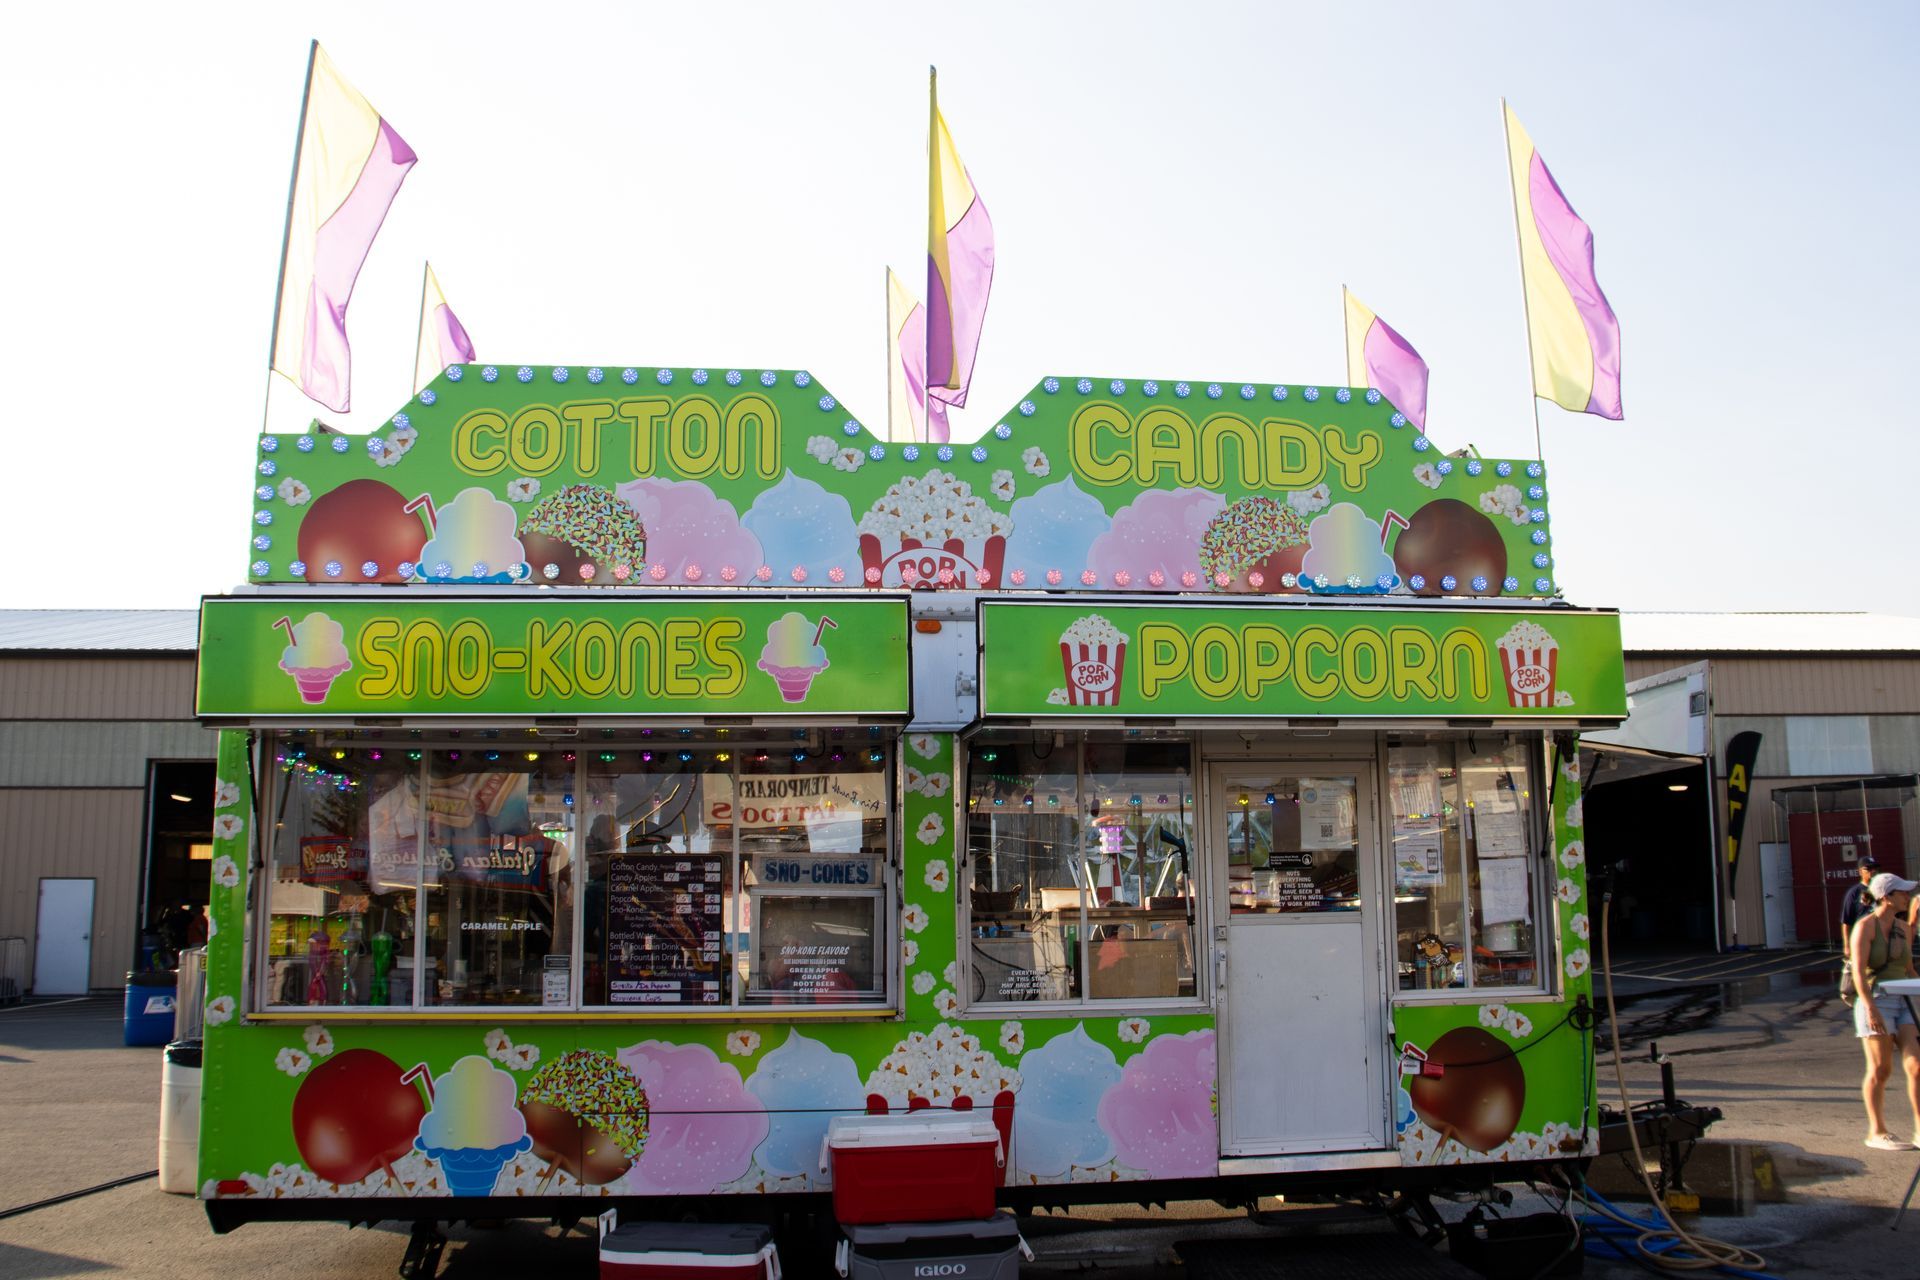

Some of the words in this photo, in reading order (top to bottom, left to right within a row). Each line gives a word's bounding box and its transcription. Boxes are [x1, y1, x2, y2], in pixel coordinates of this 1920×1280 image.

[451, 392, 782, 480] COTTON
[1068, 400, 1384, 492] CANDY
[898, 556, 957, 582] POP
[356, 617, 748, 700] SNO-KONES
[1137, 621, 1493, 702] POPCORN
[1078, 664, 1104, 675] POP
[1517, 668, 1540, 679] POP
[1078, 671, 1109, 686] CORN
[1517, 674, 1545, 689] CORN
[1822, 836, 1853, 845] POCONO
[611, 862, 635, 871] Cotton
[636, 862, 658, 872] Candy
[765, 859, 870, 884] SNO-CONES
[611, 873, 633, 882] Candy
[634, 873, 657, 882] Apples
[1826, 870, 1847, 879] FIRE
[461, 922, 508, 931] CARAMEL
[510, 922, 542, 931] APPLE
[610, 931, 635, 939] Bottled
[661, 942, 680, 951] Drink
[780, 945, 817, 956] SNO-KONE
[818, 945, 850, 956] FLAVORS
[630, 953, 660, 961] Fountain
[661, 953, 680, 961] Drink
[914, 1263, 966, 1278] IGLOO
